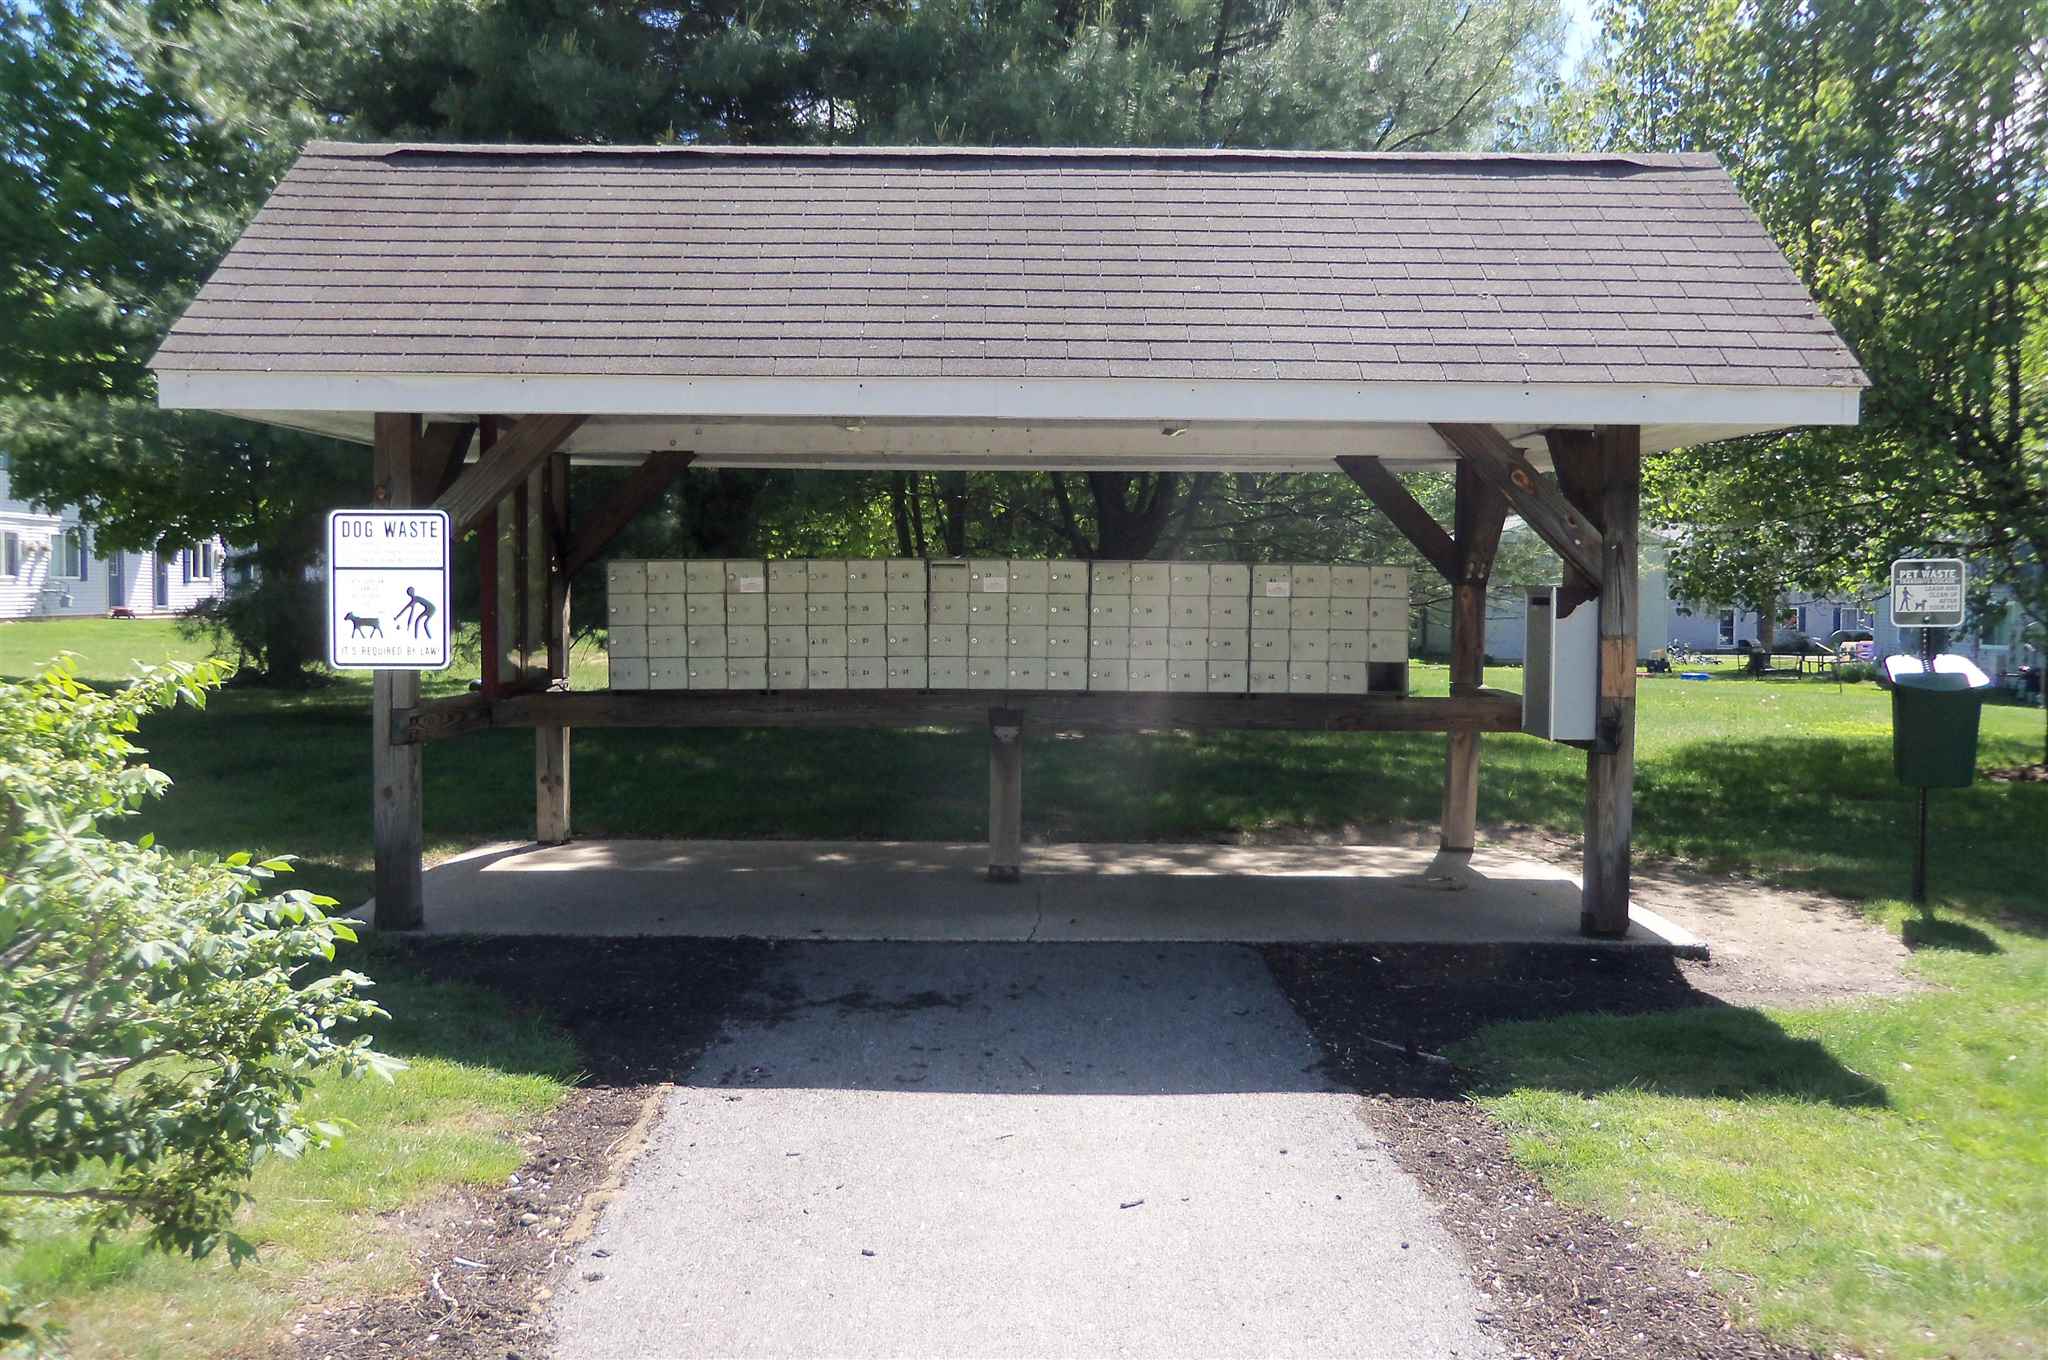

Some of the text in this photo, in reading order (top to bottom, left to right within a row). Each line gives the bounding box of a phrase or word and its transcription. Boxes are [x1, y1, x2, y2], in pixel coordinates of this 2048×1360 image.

[342, 520, 438, 538] DOG WASTE
[1899, 569, 1957, 578] PET WASTE
[341, 646, 357, 656] ITS
[361, 646, 403, 656] REQUIRED
